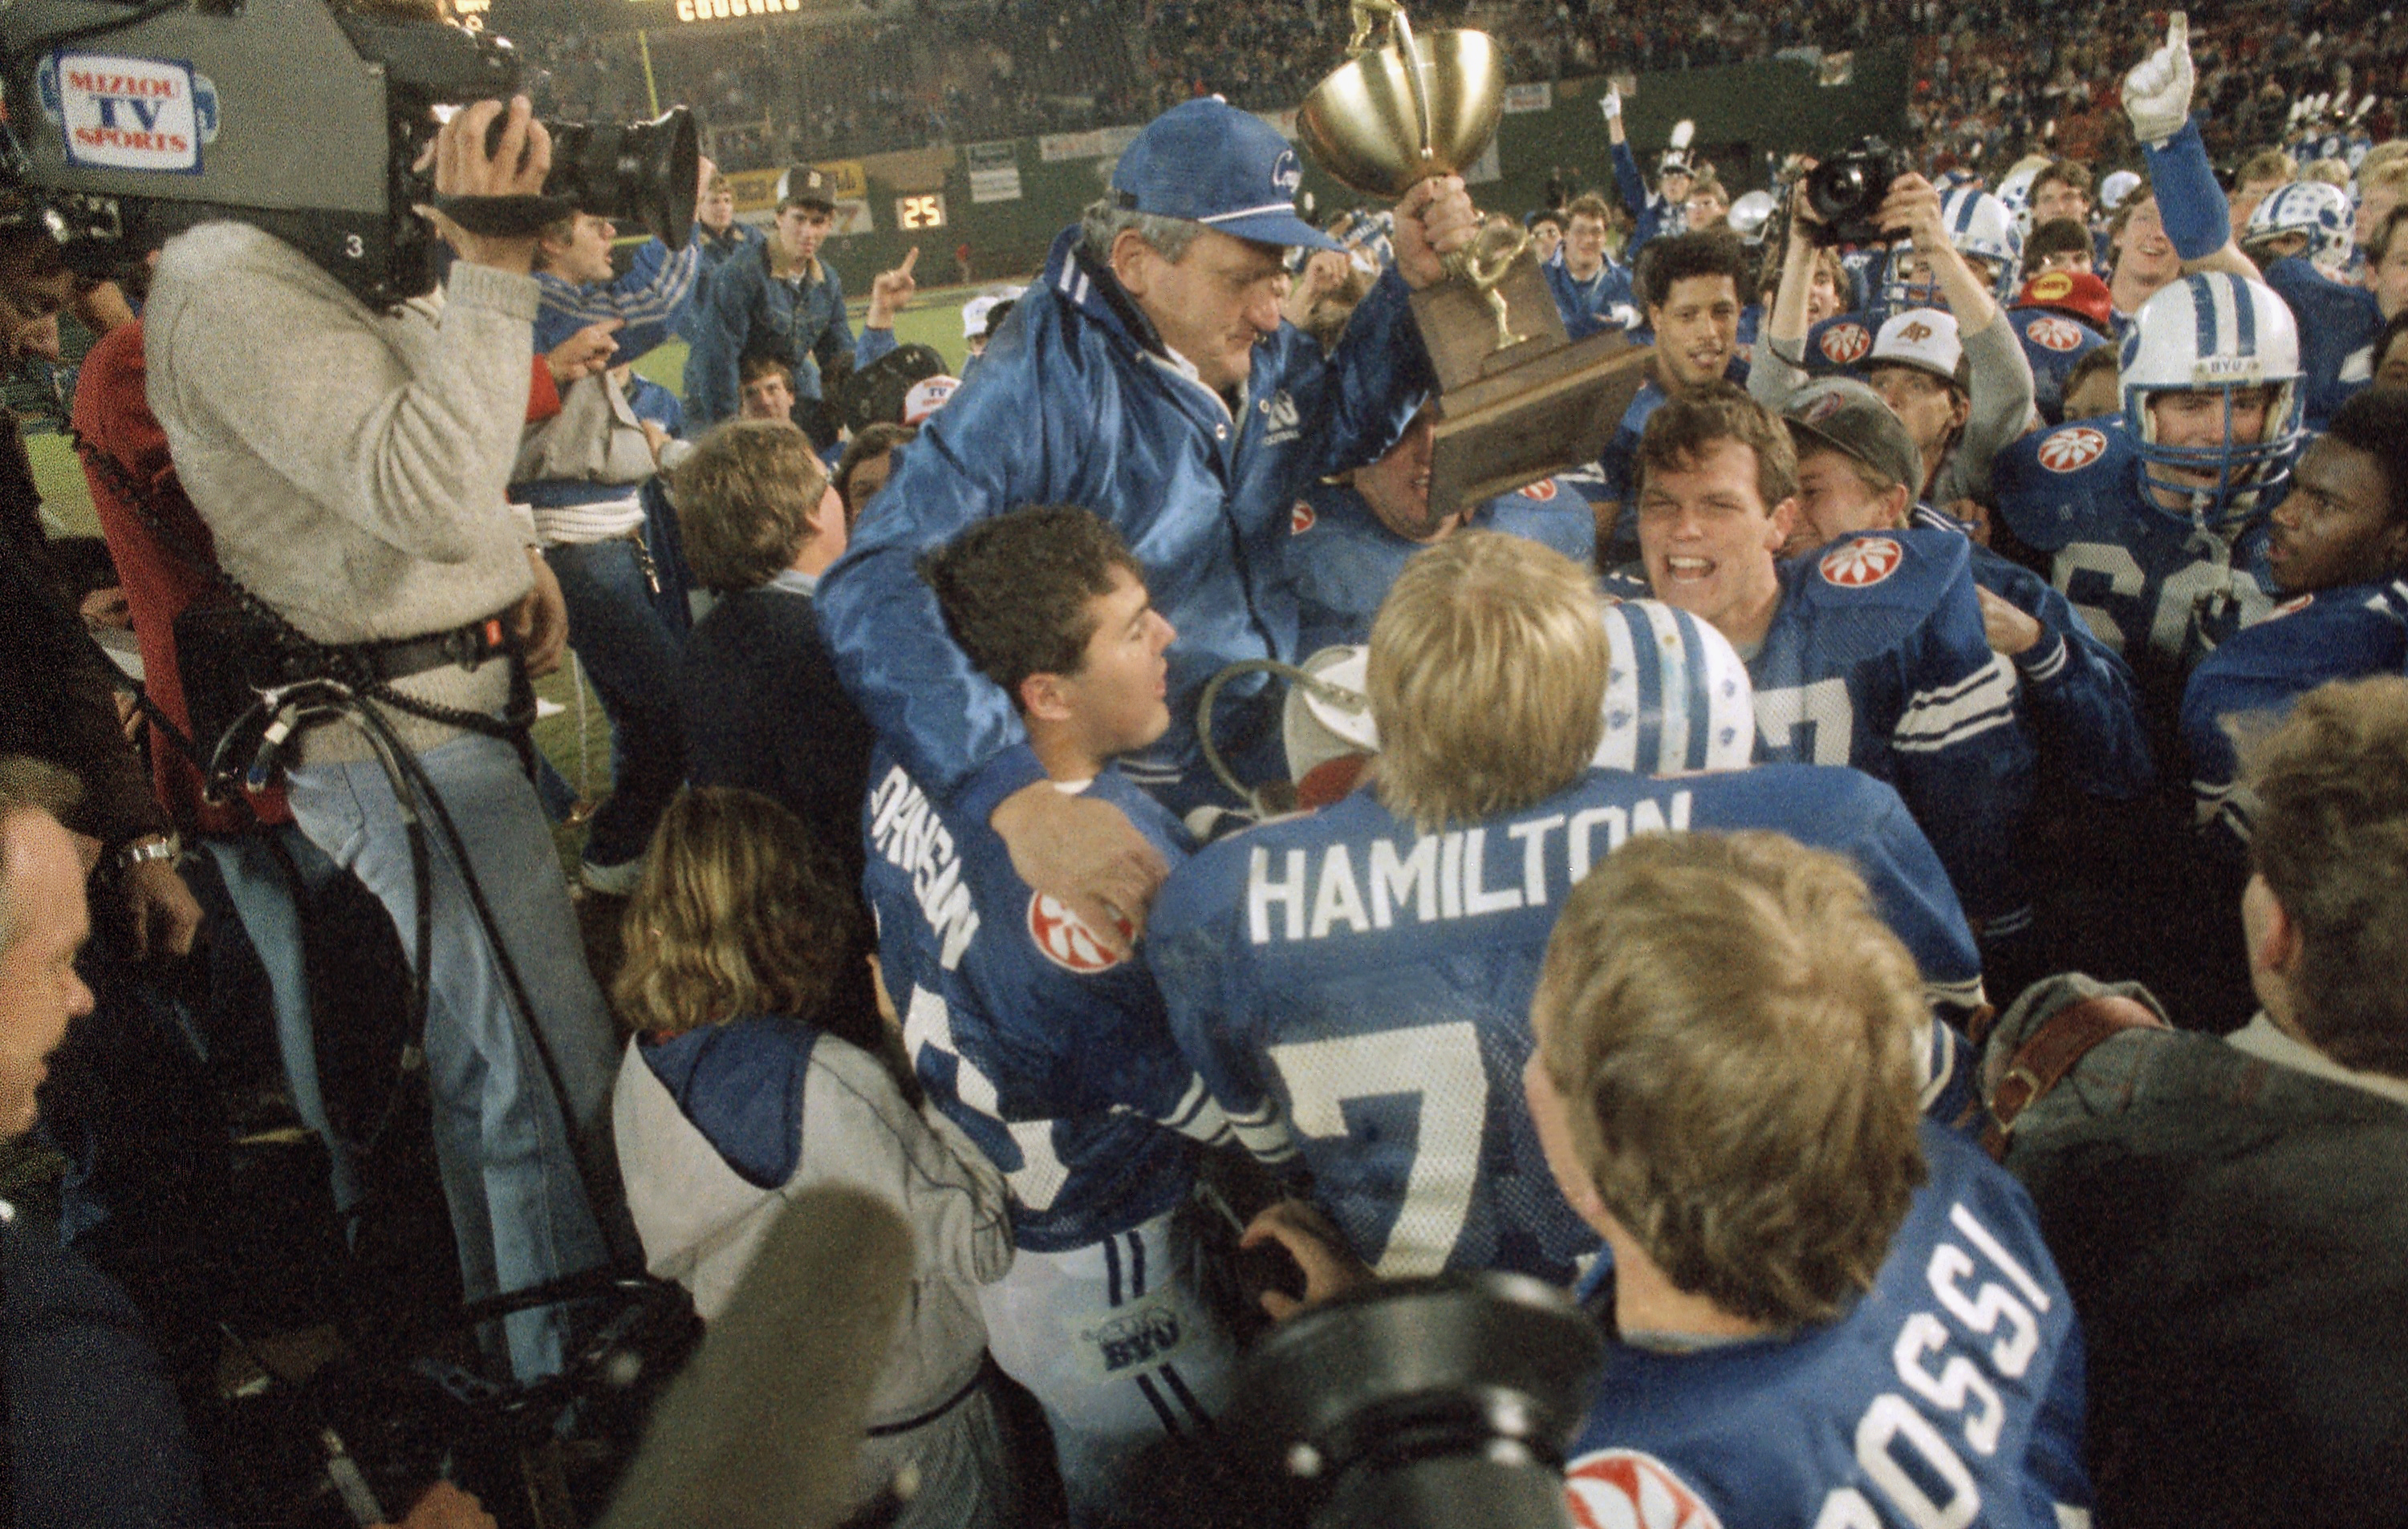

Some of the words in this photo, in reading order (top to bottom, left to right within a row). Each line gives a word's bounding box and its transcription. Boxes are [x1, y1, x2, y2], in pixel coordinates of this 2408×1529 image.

[89, 94, 166, 131] TV
[75, 128, 189, 153] SPORTS
[904, 196, 941, 229] 25
[346, 234, 364, 258] 3
[1268, 1020, 1488, 1279] 7
[1099, 1319, 1180, 1372] BYU
[1809, 1203, 2051, 1529] OSSI
